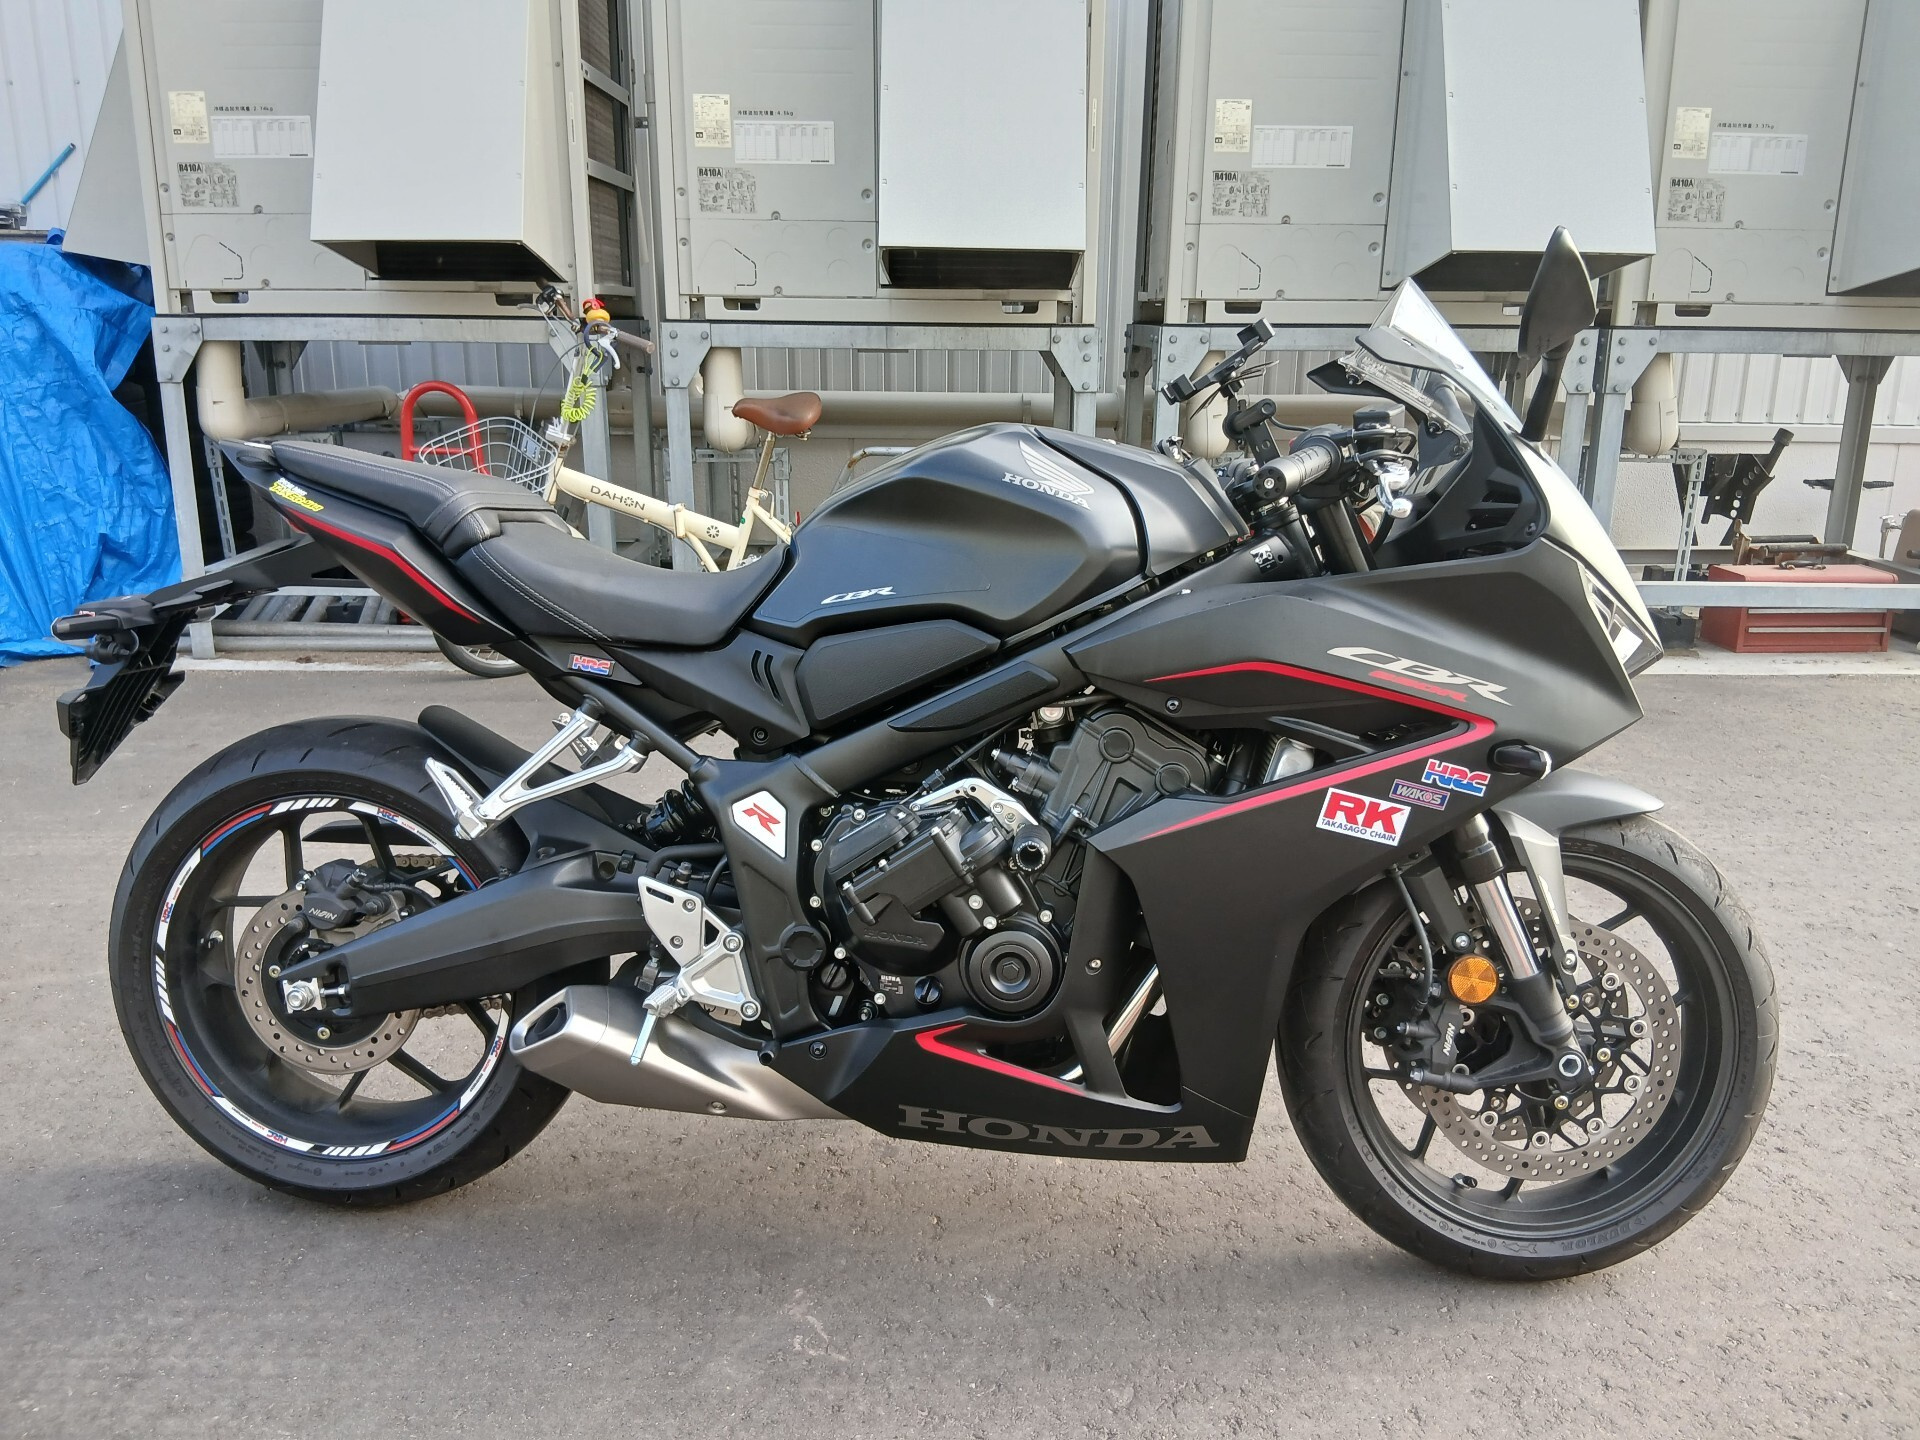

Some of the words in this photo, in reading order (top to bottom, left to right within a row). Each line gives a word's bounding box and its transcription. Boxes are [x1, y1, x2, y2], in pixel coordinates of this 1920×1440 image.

[178, 163, 202, 172] R410A
[698, 168, 722, 177] R410A
[1214, 172, 1237, 181] R410A
[1671, 178, 1694, 188] R410A
[590, 485, 646, 511] DAHON
[1001, 471, 1092, 512] HONDA
[820, 586, 897, 605] CBR
[571, 655, 611, 675] HRC
[1326, 646, 1514, 706] CBR
[1422, 759, 1491, 797] HRC
[377, 807, 400, 822] HRC
[1323, 791, 1405, 835] RK
[1321, 818, 1367, 836] TAKASAGO
[1369, 830, 1397, 843] CHAIN
[161, 902, 173, 923] HRC
[864, 928, 928, 947] HONDA
[491, 1036, 503, 1057] HRC
[898, 1104, 1220, 1149] HONDA
[267, 1130, 288, 1144] HRC
